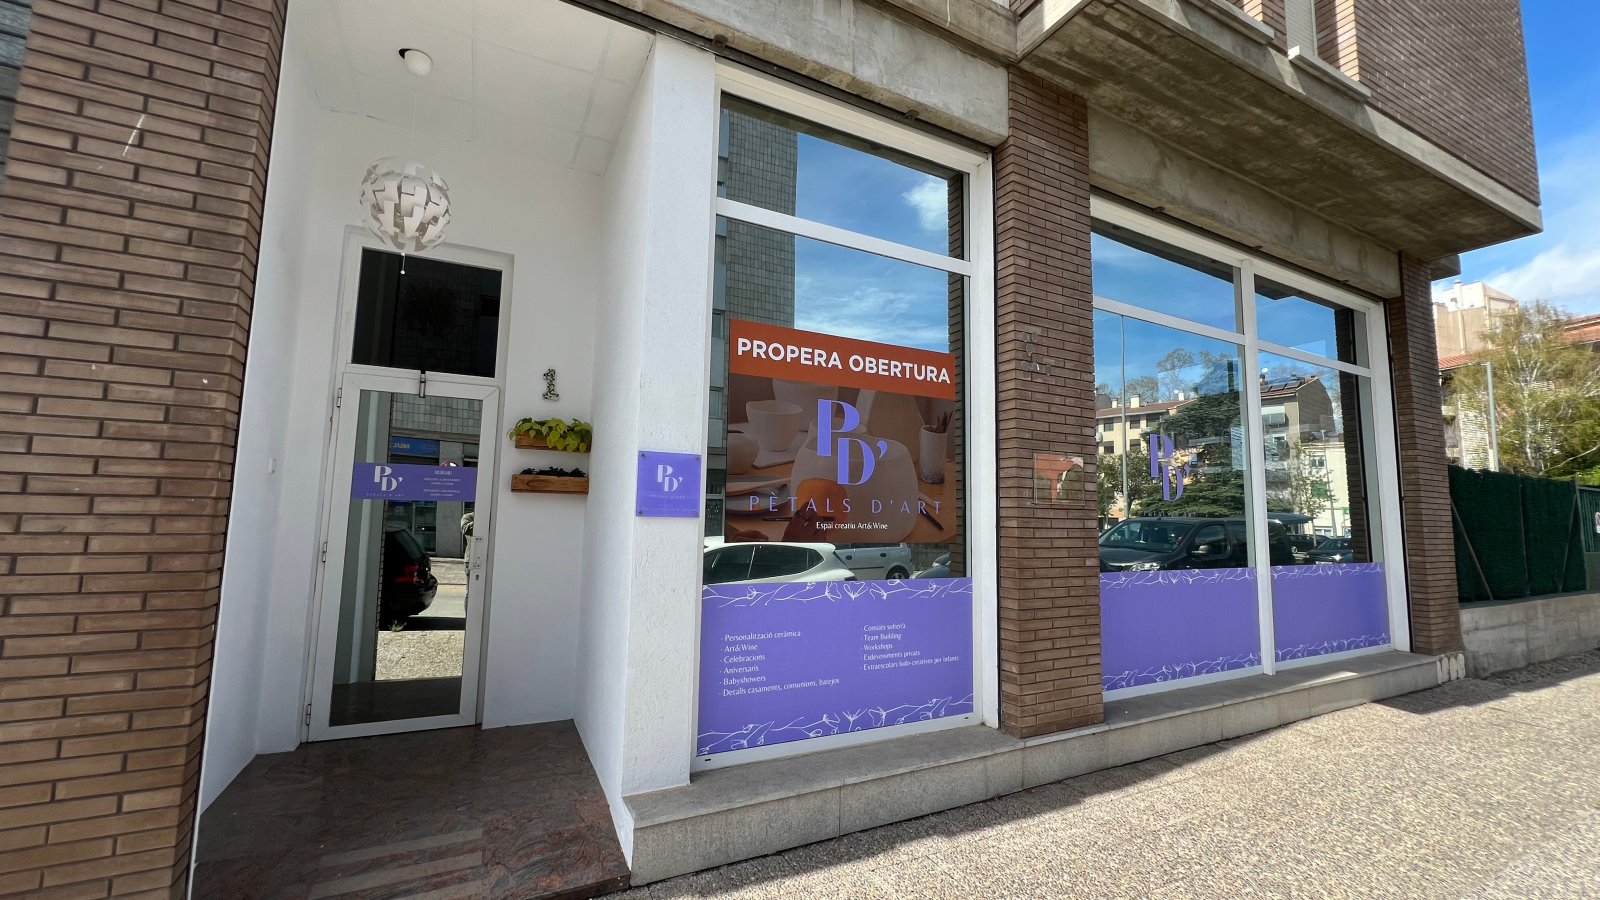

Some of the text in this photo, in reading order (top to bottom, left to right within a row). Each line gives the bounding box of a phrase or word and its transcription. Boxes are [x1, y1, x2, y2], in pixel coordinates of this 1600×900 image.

[736, 337, 951, 384] PROPERA OBERTURA
[749, 491, 942, 515] PÈTALS D'ART
[816, 521, 888, 531] Espai creatiu Art&Wine
[724, 631, 773, 641] Personalització
[880, 632, 902, 641] Building
[724, 643, 758, 652] Art&Wine
[863, 643, 893, 651] Workshops
[724, 653, 766, 663] Celebracions
[863, 650, 920, 661] Esdeveniments privats
[724, 664, 759, 674] Aniversaris
[863, 662, 898, 671] Extraescolars
[723, 675, 766, 686] Babyshowers
[723, 687, 747, 697] Detalls
[747, 684, 783, 694] casaments,
[783, 680, 818, 690] comunions,
